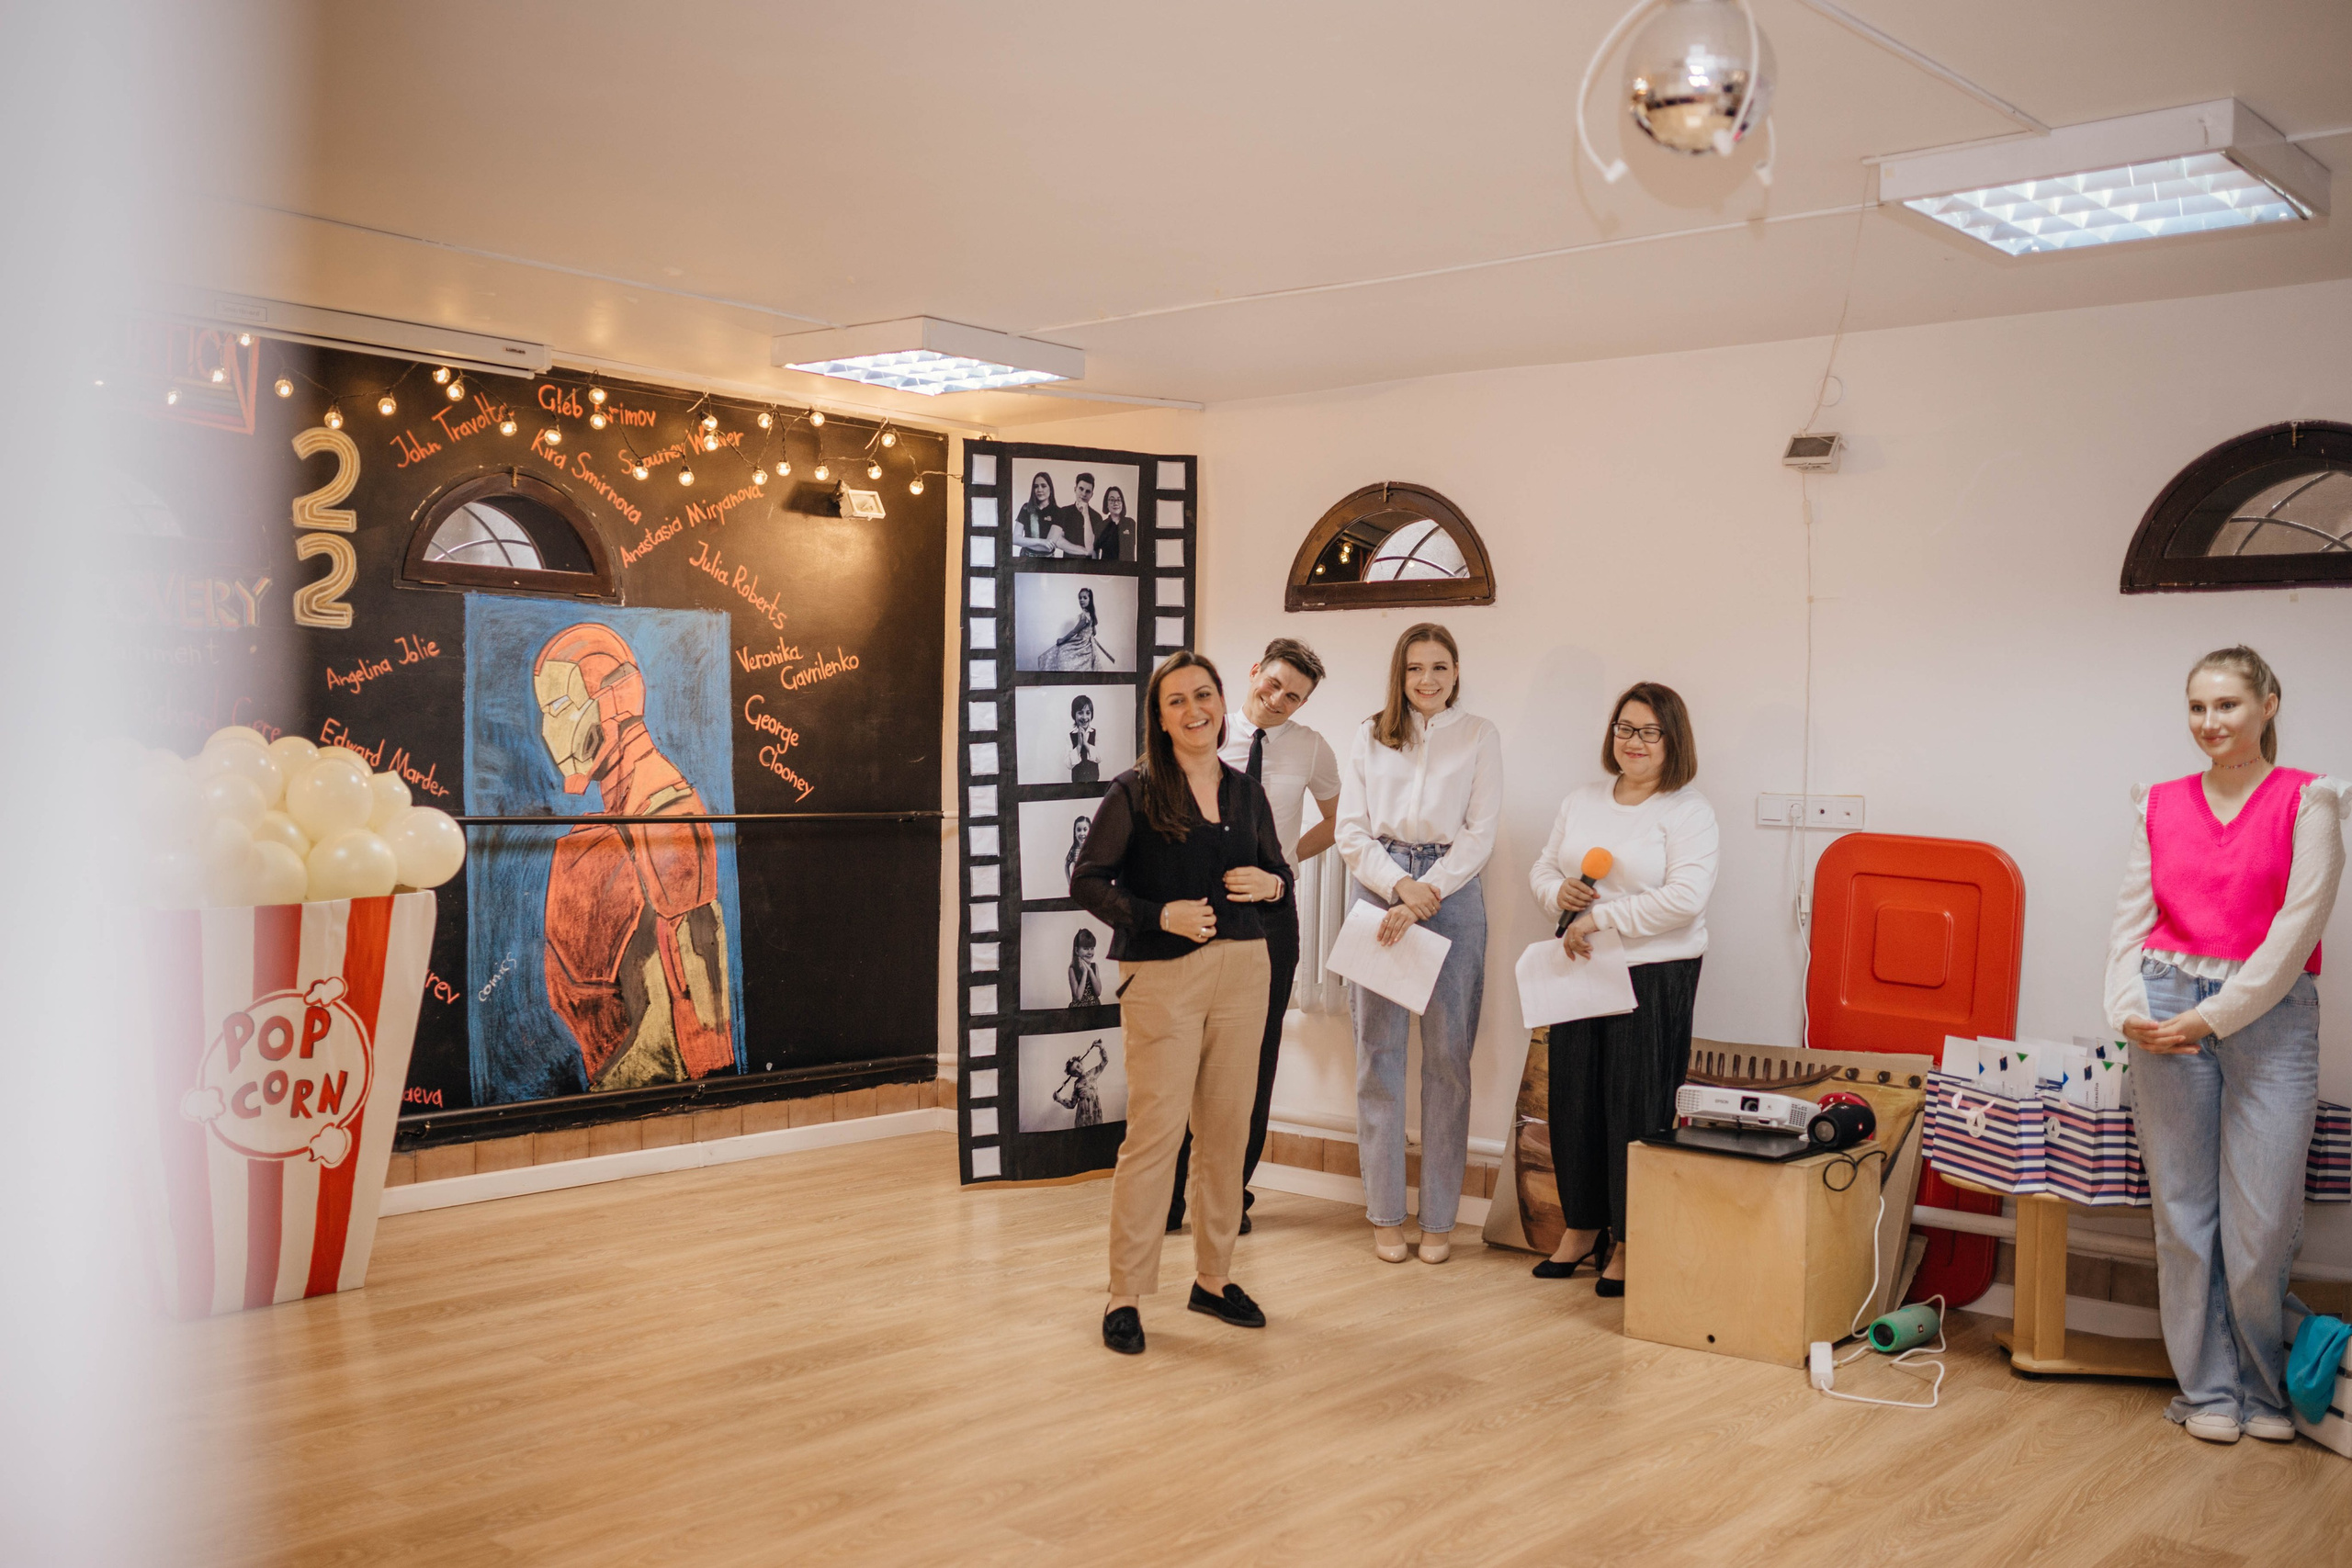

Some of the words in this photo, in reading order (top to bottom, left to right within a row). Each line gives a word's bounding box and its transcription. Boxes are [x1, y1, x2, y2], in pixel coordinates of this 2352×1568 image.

[537, 385, 583, 419] Gleb
[390, 429, 442, 468] John
[684, 423, 744, 456] Wver
[530, 428, 567, 469] Kira
[571, 451, 642, 525] Smirnova
[620, 515, 684, 569] Anastasia
[685, 484, 764, 526] Miryanova
[689, 540, 729, 586] Julia
[732, 564, 787, 630] Roberts
[326, 659, 393, 694] Angelina
[394, 634, 441, 665] Jolie
[735, 637, 804, 672] Veronika
[781, 646, 860, 691] Gavrilenko
[744, 694, 799, 755] George
[320, 717, 386, 767] Edward
[388, 747, 449, 797] Marder
[759, 745, 815, 804] Clooney
[478, 951, 517, 1002] comics
[222, 1005, 332, 1074] POP
[231, 1069, 348, 1120] CORN
[401, 1086, 444, 1109] aeva
